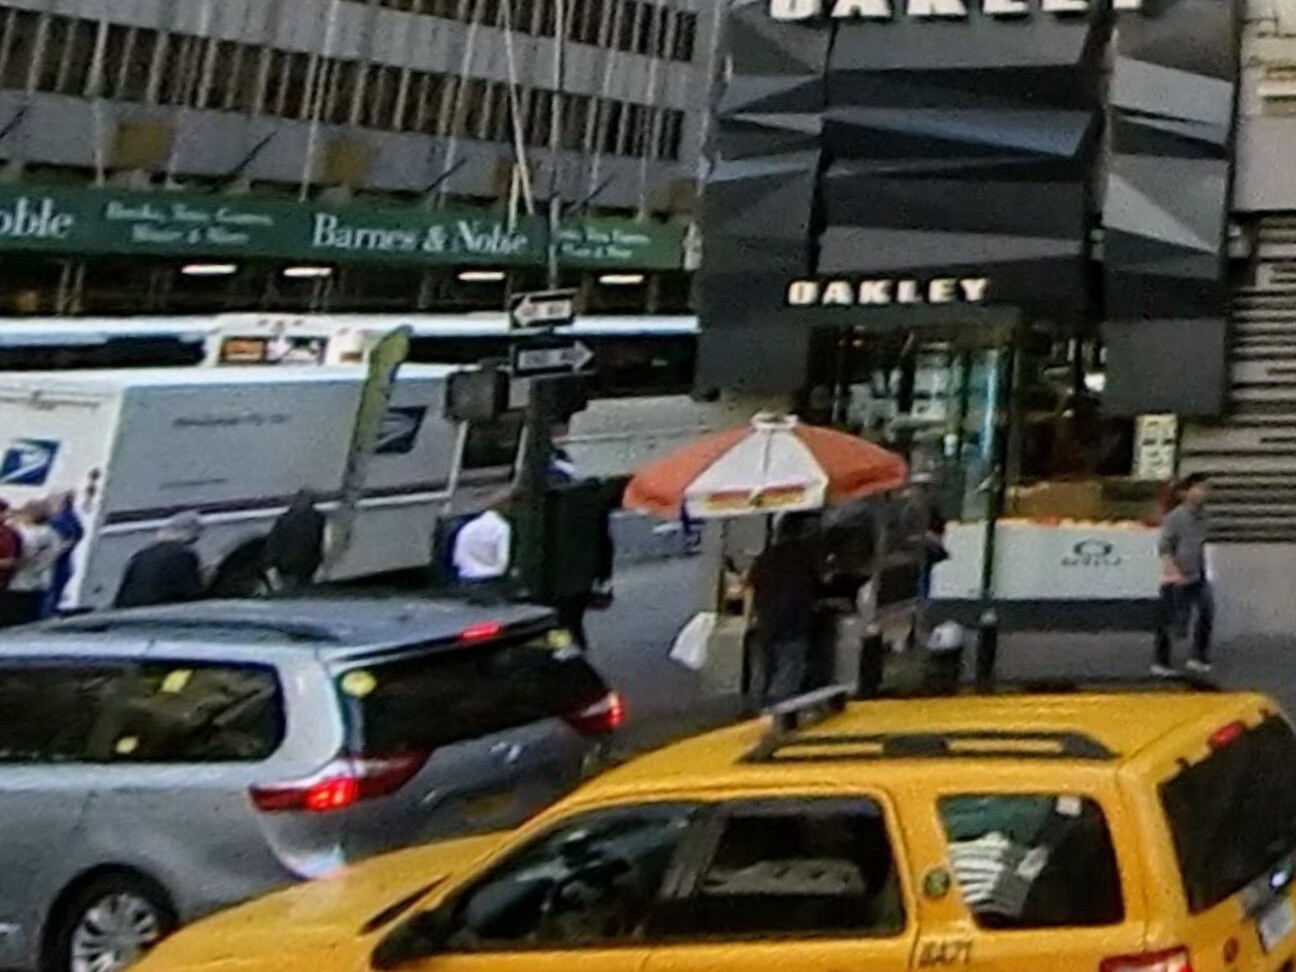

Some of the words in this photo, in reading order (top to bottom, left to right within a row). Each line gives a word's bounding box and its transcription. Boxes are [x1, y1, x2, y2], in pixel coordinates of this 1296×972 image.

[313, 212, 416, 250] Barnes
[423, 224, 446, 252] &
[788, 278, 988, 305] OAKLEY
